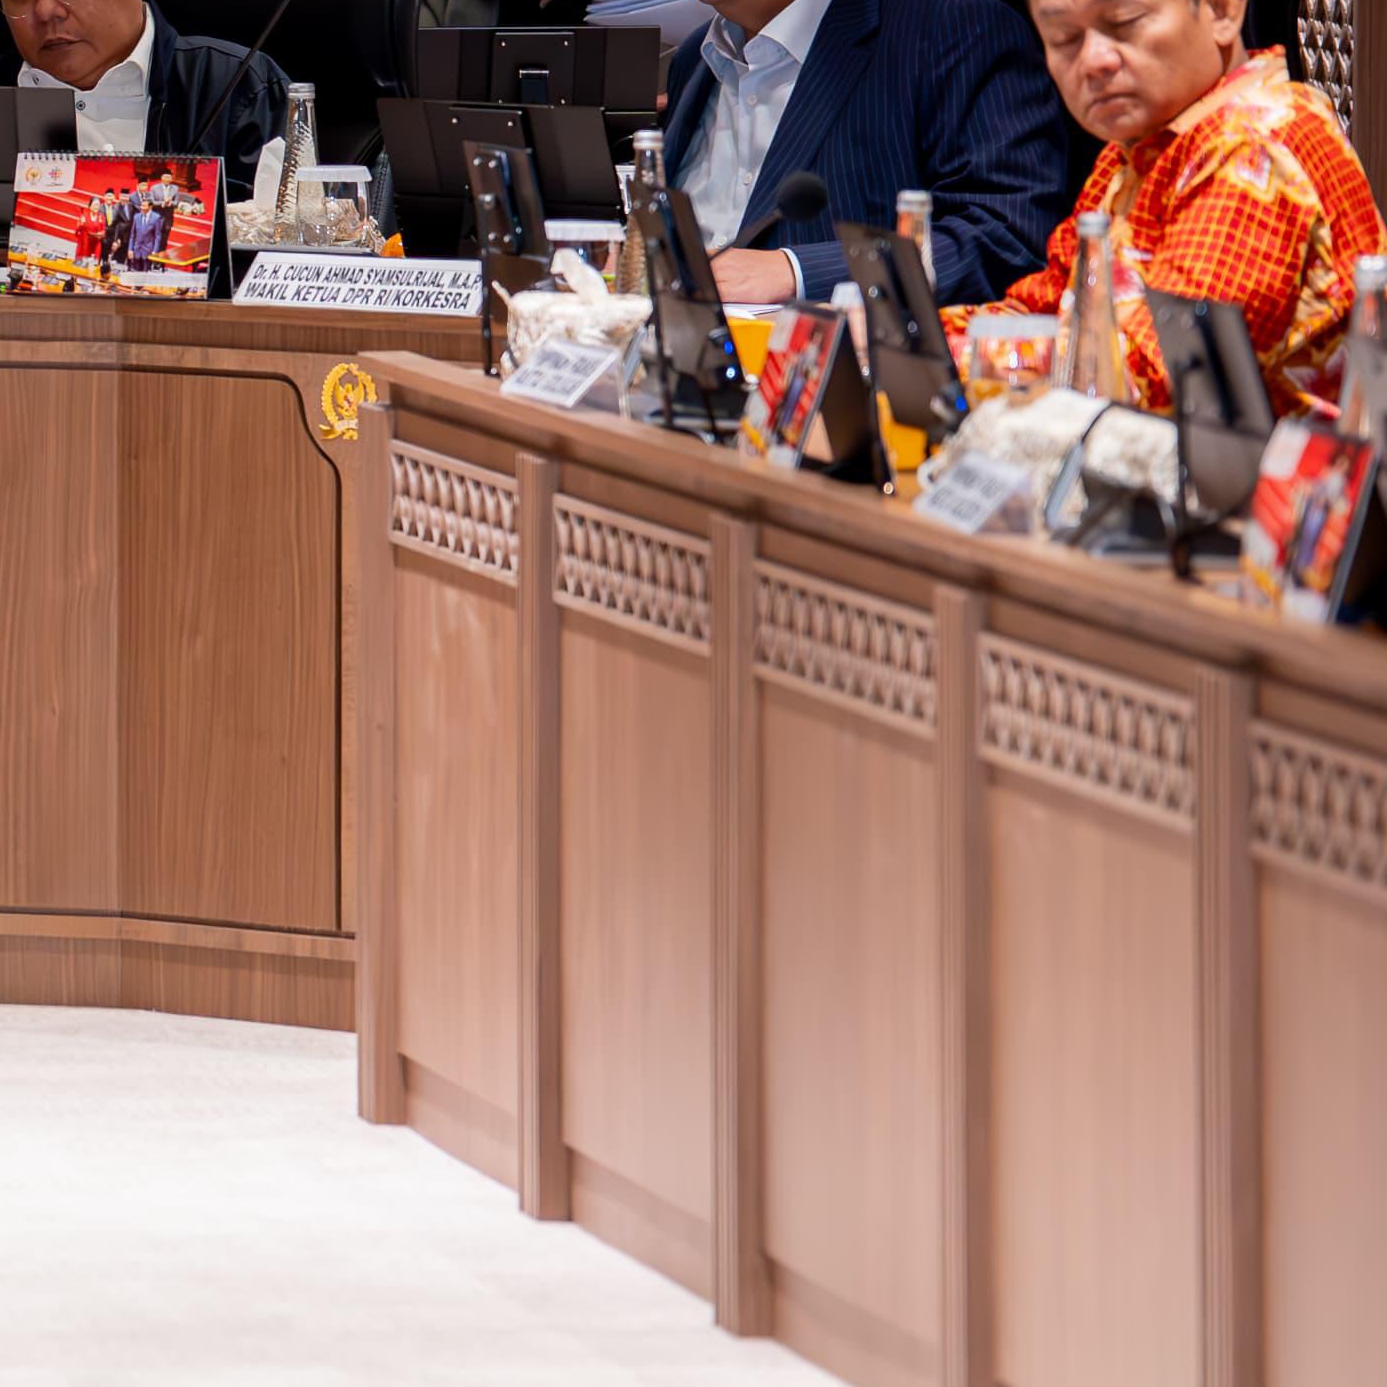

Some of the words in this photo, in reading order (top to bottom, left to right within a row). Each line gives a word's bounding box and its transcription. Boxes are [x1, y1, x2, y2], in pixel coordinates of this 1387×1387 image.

[252, 264, 266, 280] Dr.
[270, 265, 284, 281] H.
[283, 266, 323, 283] CUCUN
[324, 267, 364, 285] AHMAD
[244, 281, 288, 300] WAKIL
[290, 283, 340, 304] KETUA
[342, 286, 373, 306] DPR
[375, 289, 472, 310] RI/KORKESRA
